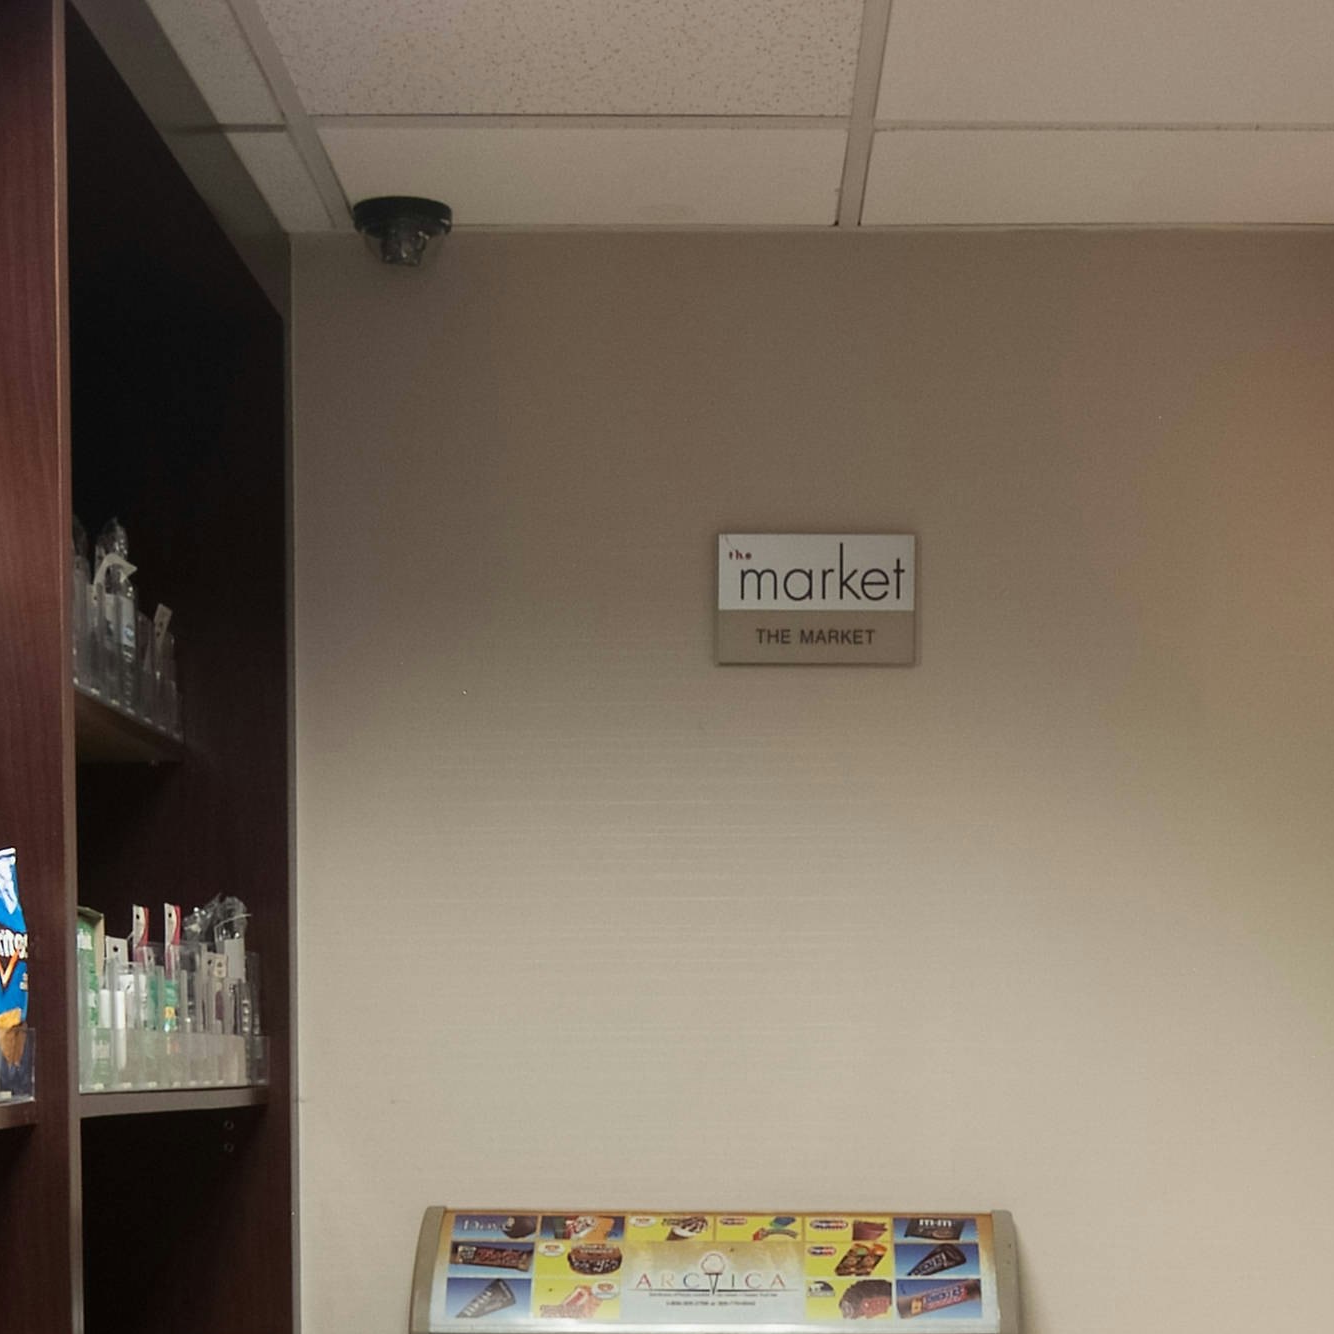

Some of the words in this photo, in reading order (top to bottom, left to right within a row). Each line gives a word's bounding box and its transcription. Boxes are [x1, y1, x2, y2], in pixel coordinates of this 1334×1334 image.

[728, 549, 752, 560] the
[740, 542, 905, 601] market
[756, 628, 791, 644] THE
[799, 628, 875, 644] MARKET
